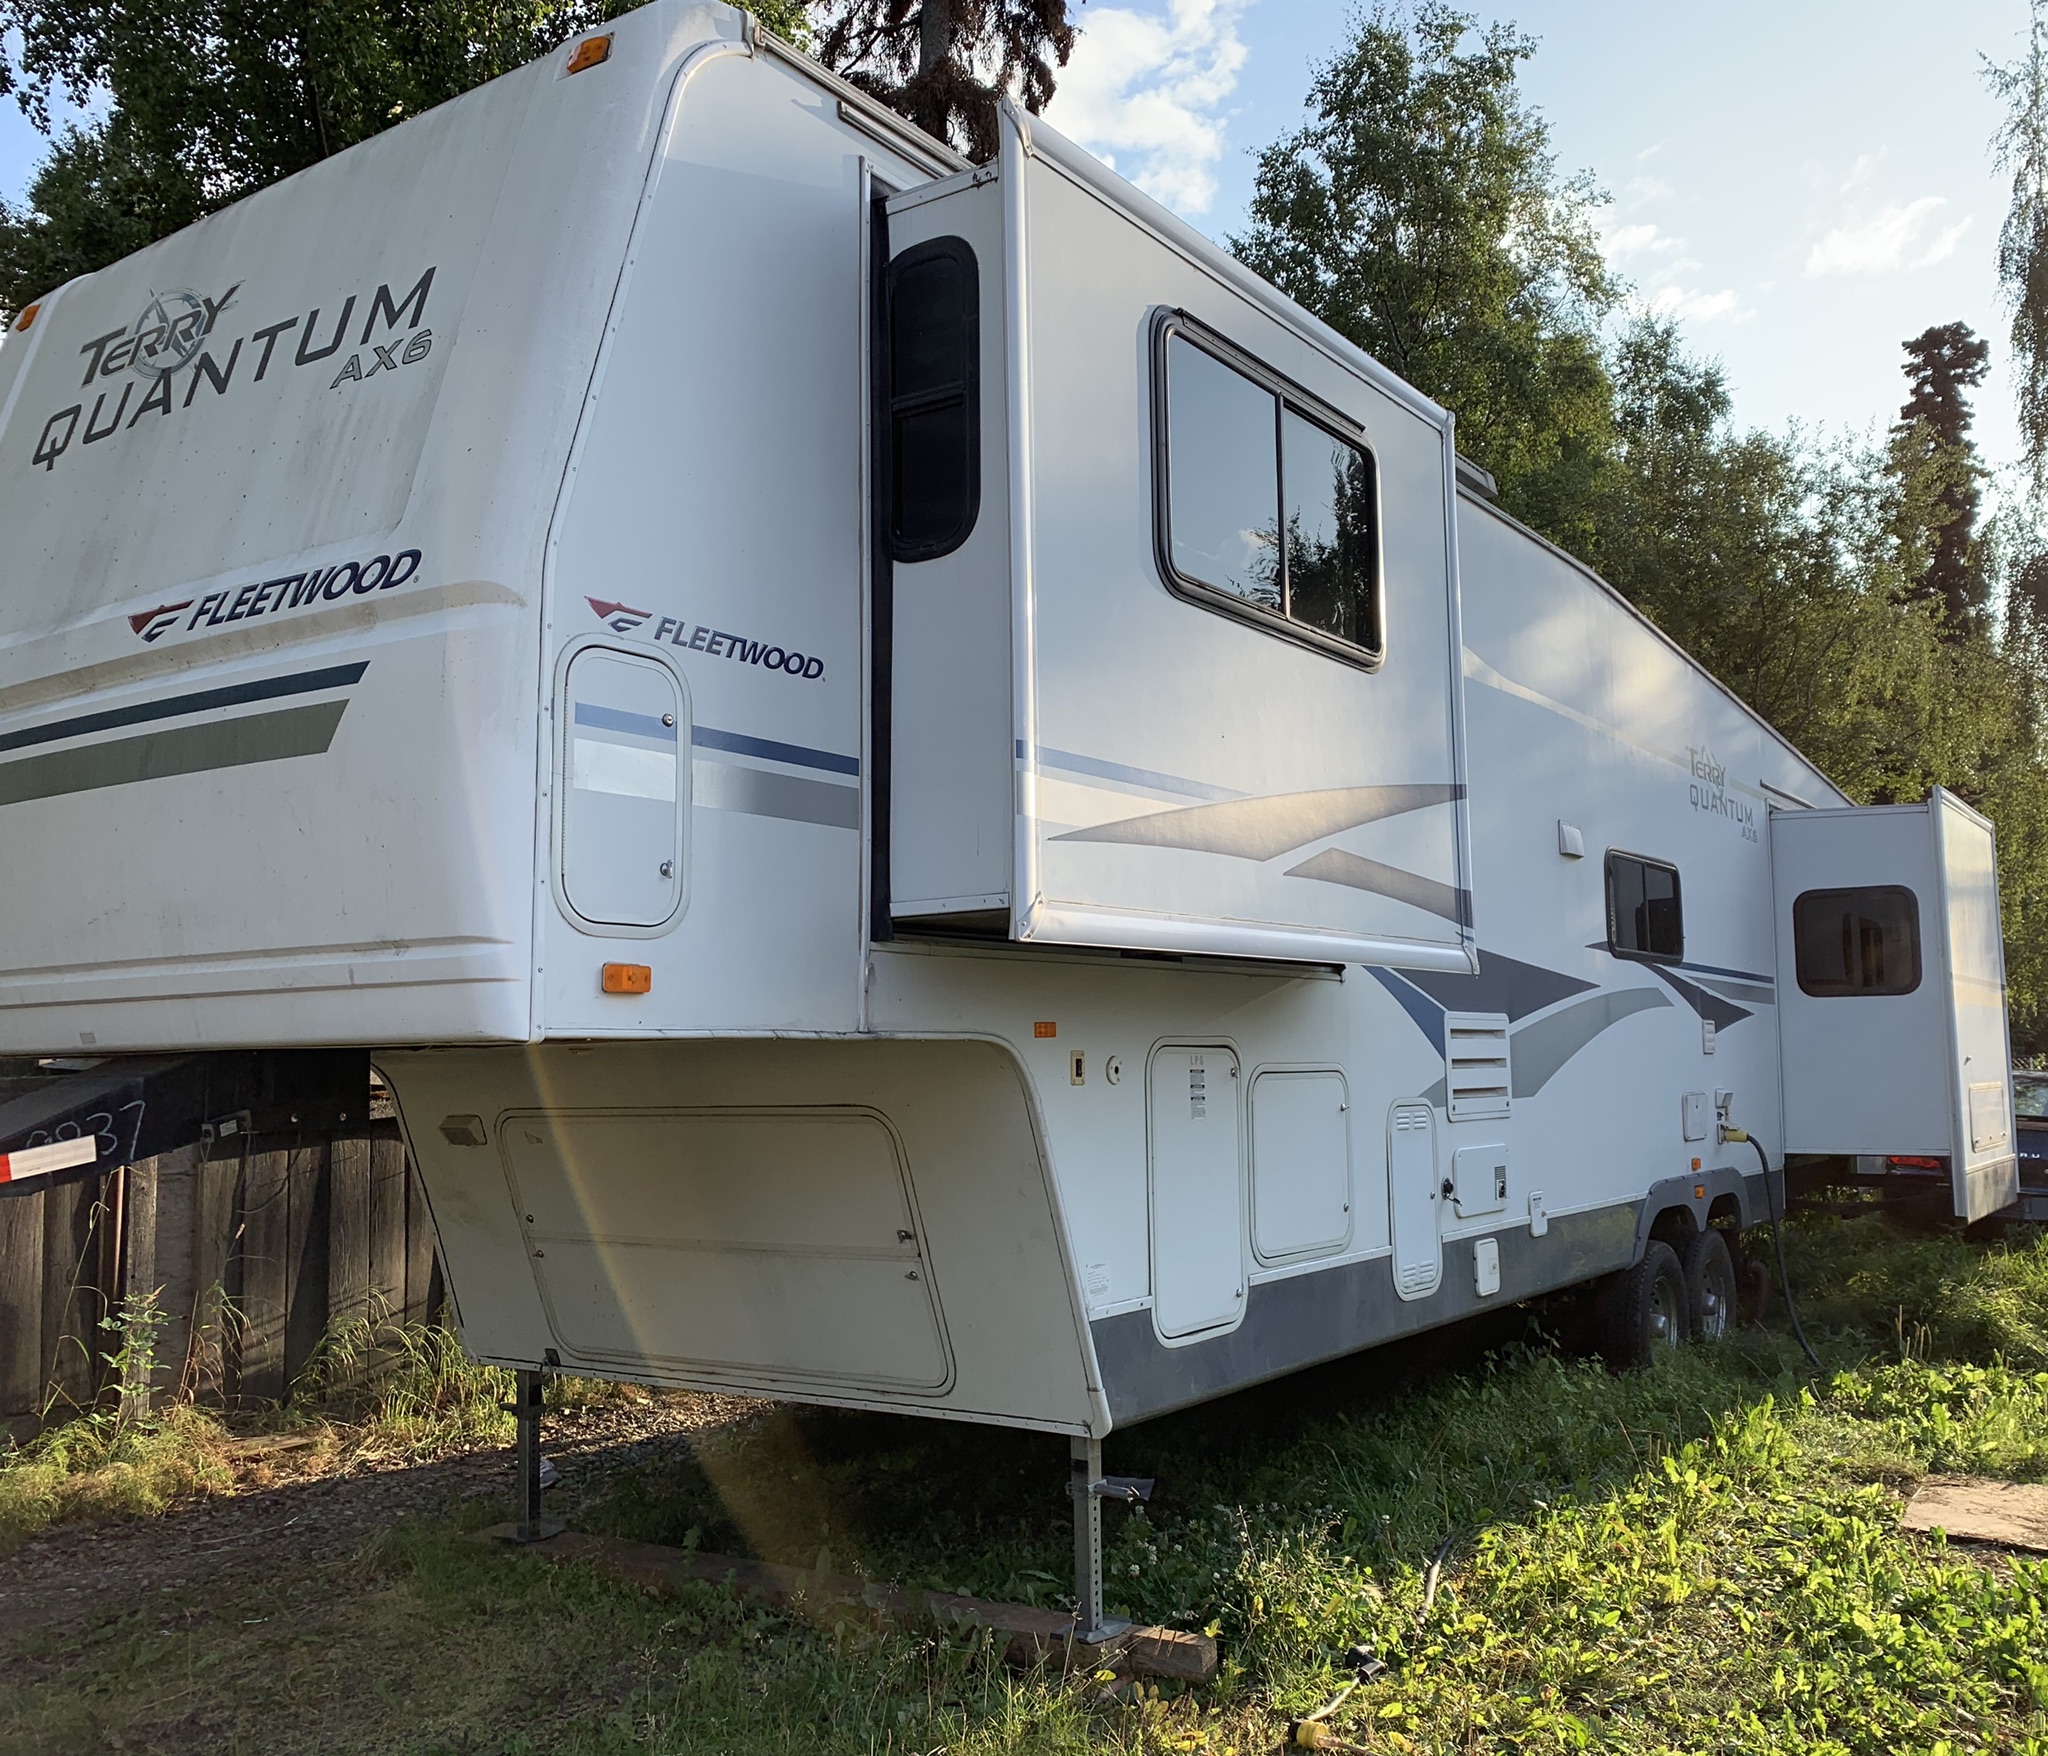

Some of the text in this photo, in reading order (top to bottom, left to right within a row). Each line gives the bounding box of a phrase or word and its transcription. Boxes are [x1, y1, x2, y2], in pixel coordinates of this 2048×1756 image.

[80, 280, 246, 389] TERRY
[329, 329, 433, 390] AX6
[32, 265, 438, 472] QUANTUM
[186, 548, 422, 632] FLEETWOOD
[653, 616, 825, 680] FLEETWOOD
[1685, 746, 1726, 788] TERRY
[1689, 783, 1754, 827] QUANTUM
